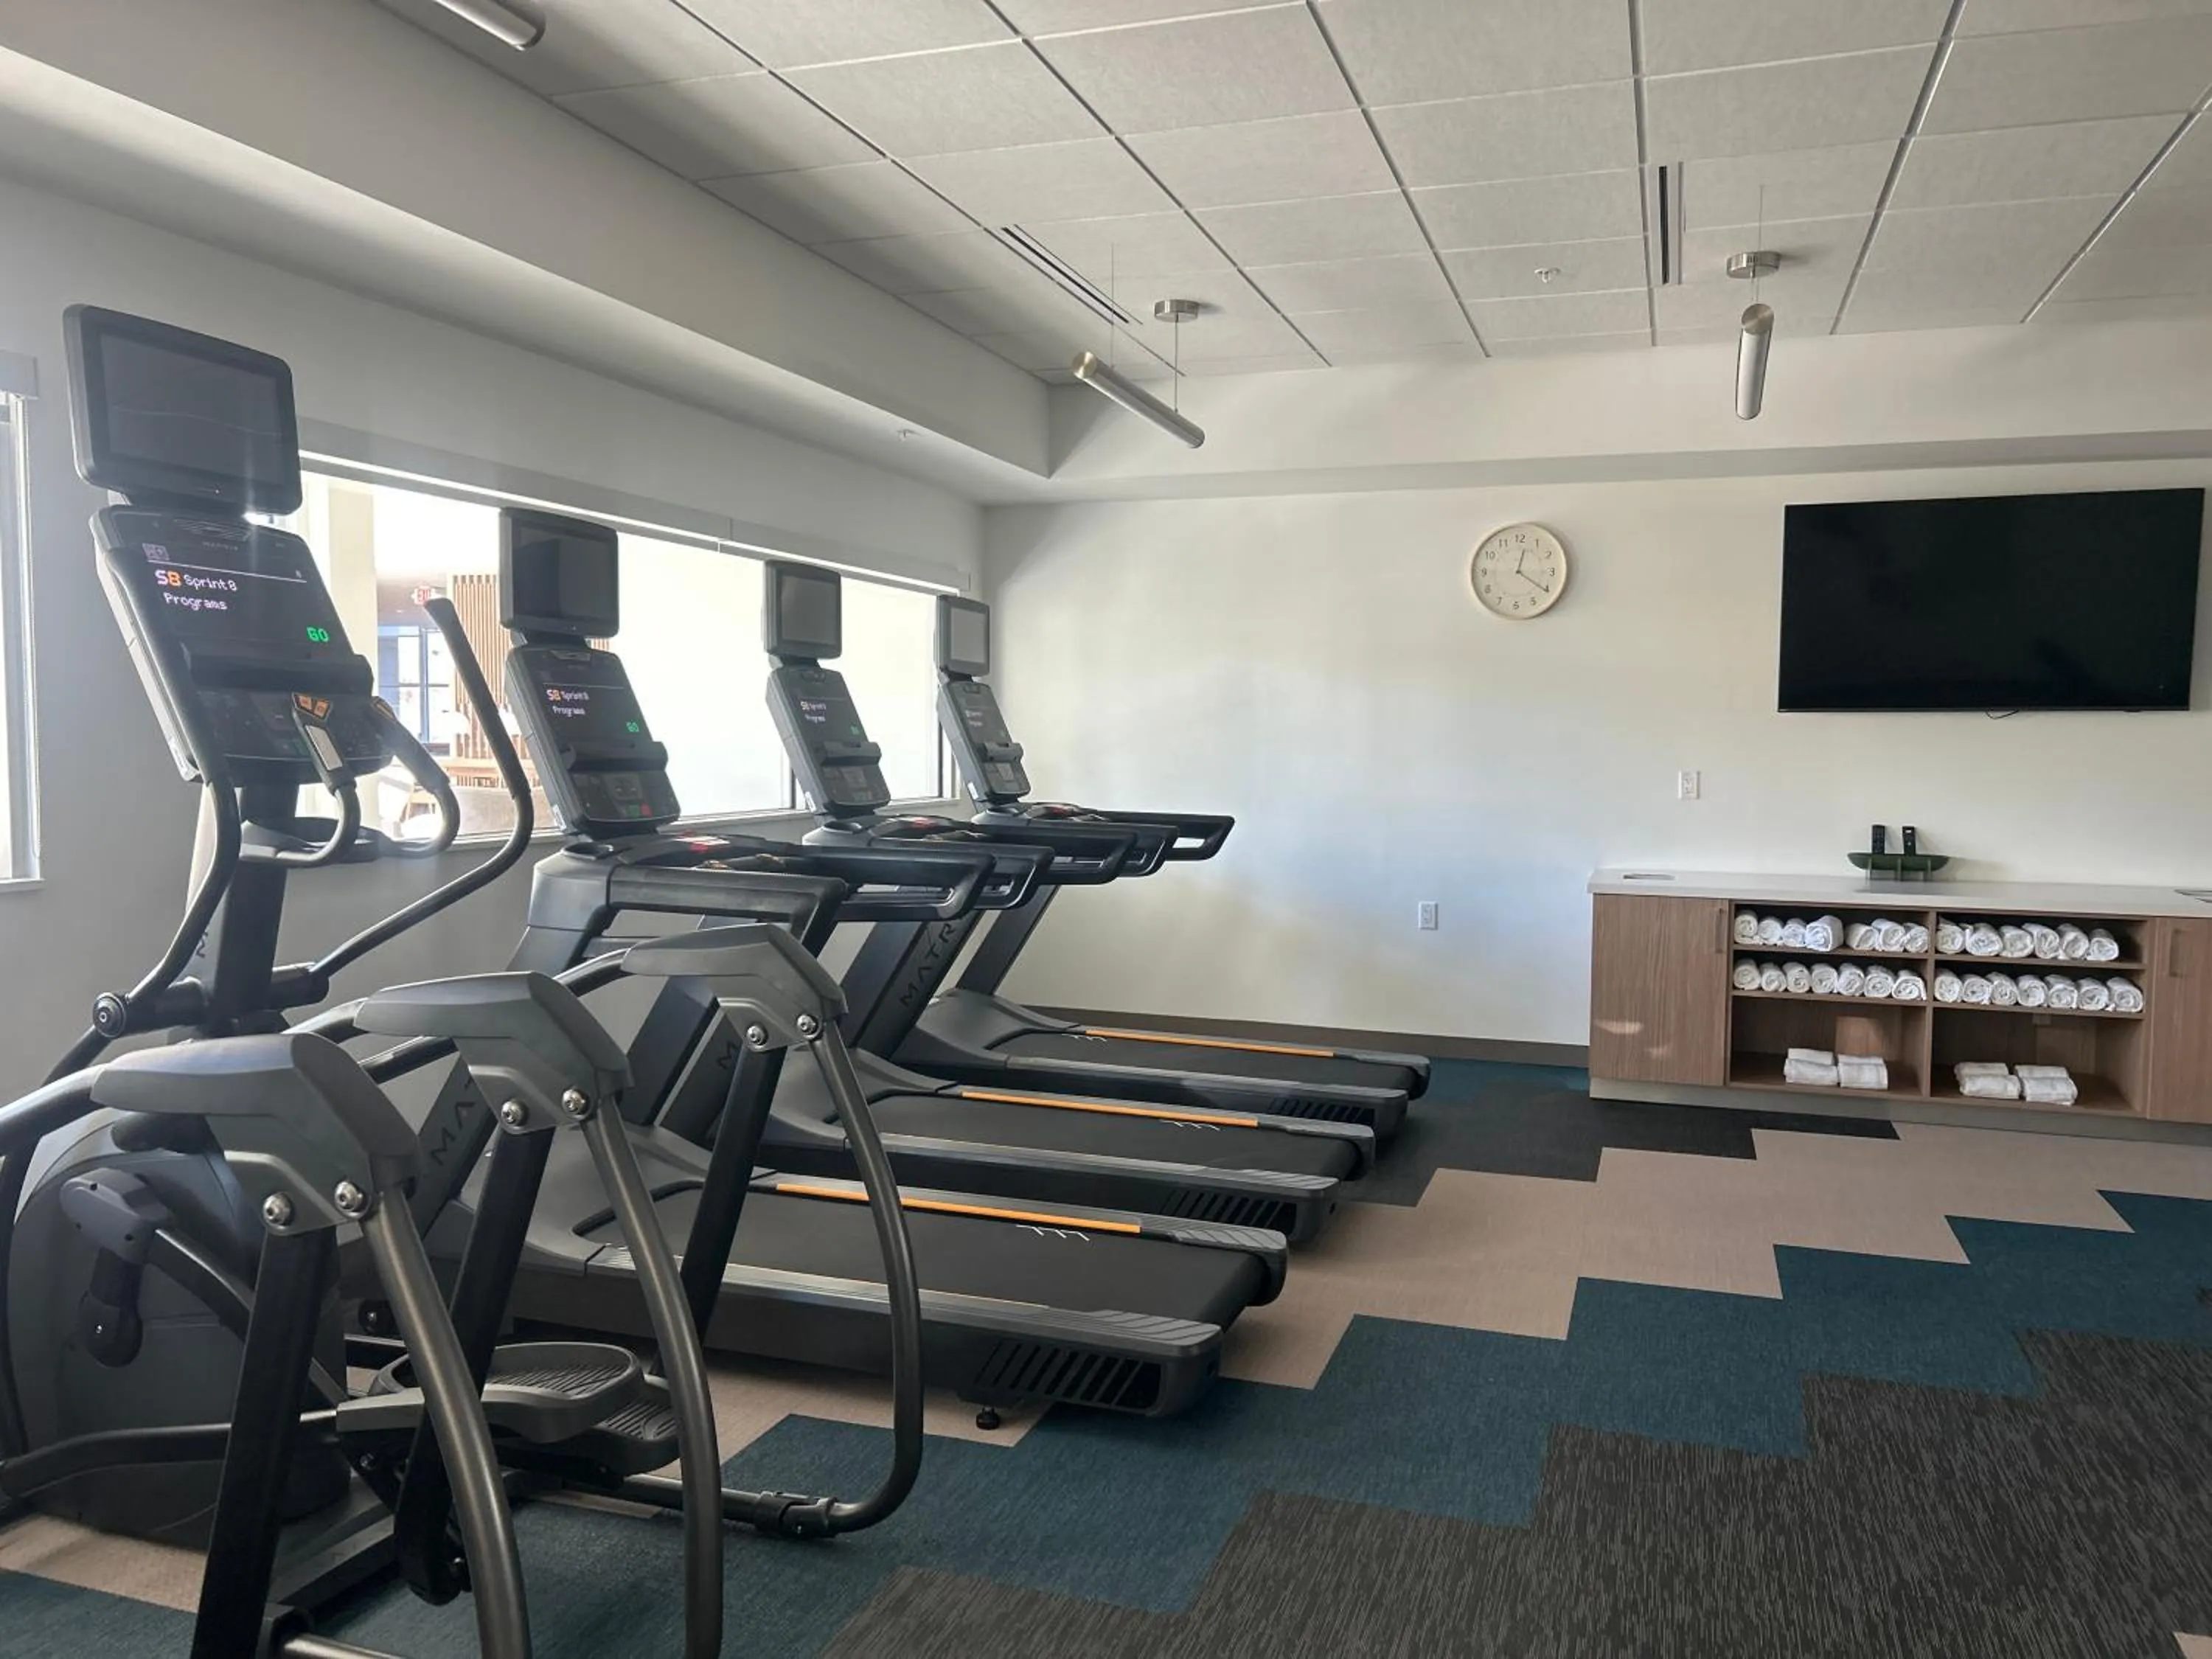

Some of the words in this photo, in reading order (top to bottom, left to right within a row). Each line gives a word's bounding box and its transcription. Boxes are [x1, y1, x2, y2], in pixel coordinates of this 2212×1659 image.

[1499, 538, 1509, 548] 11
[1515, 534, 1526, 543] 12
[1485, 551, 1496, 560] 10
[1545, 551, 1552, 560] 2
[1481, 567, 1487, 577] 9
[1548, 567, 1555, 577] 3
[155, 569, 182, 587] S8
[184, 574, 228, 591] Sprint
[1484, 585, 1491, 594] 8
[163, 591, 228, 611] Programs
[1497, 597, 1503, 605] 7
[1530, 597, 1537, 606] 5
[307, 627, 330, 643] GO
[899, 922, 957, 1008] MATR
